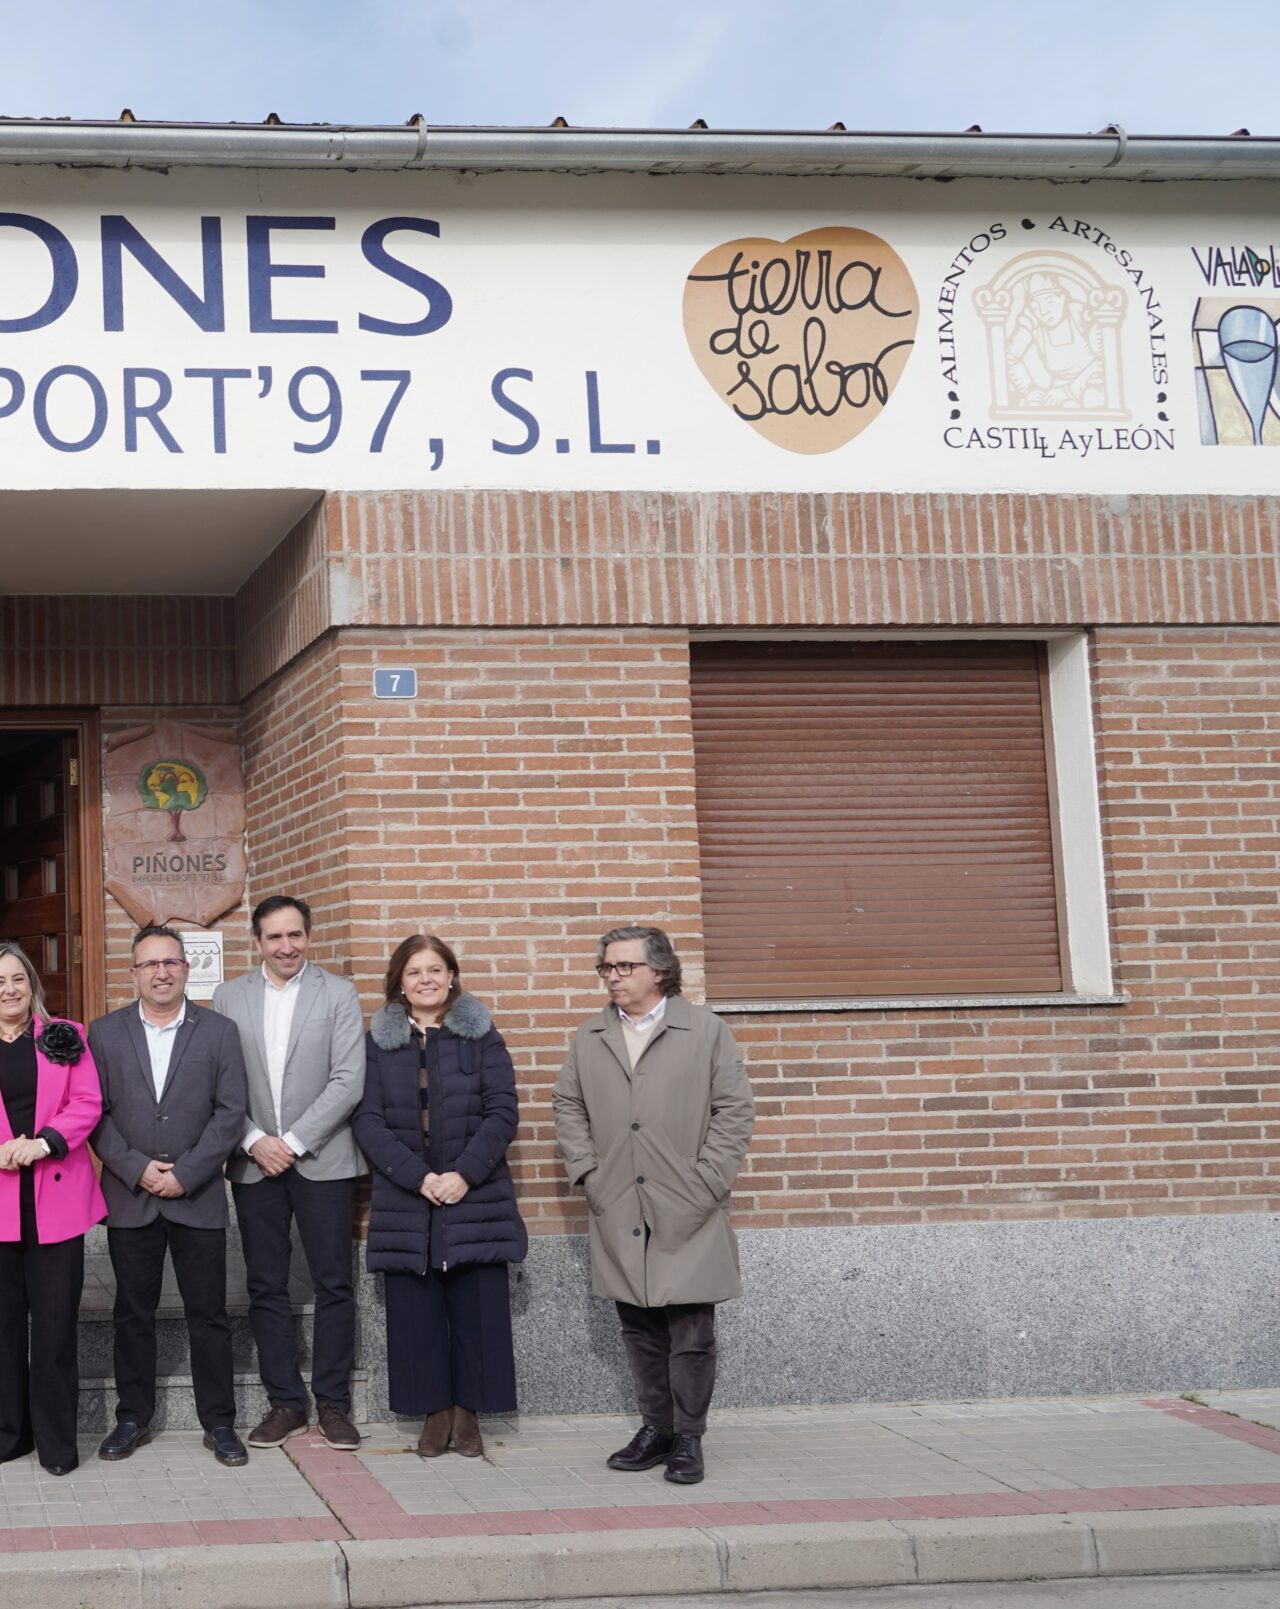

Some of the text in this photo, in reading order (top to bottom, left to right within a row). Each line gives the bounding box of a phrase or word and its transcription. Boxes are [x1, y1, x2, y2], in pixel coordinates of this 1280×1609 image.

[686, 248, 913, 318] tierra
[939, 221, 1008, 386] ALIMENTOS
[708, 310, 780, 359] de
[726, 316, 915, 422] sabor
[490, 367, 662, 455] S.L.
[389, 674, 401, 693] 7
[132, 850, 228, 874] PIÑONES
